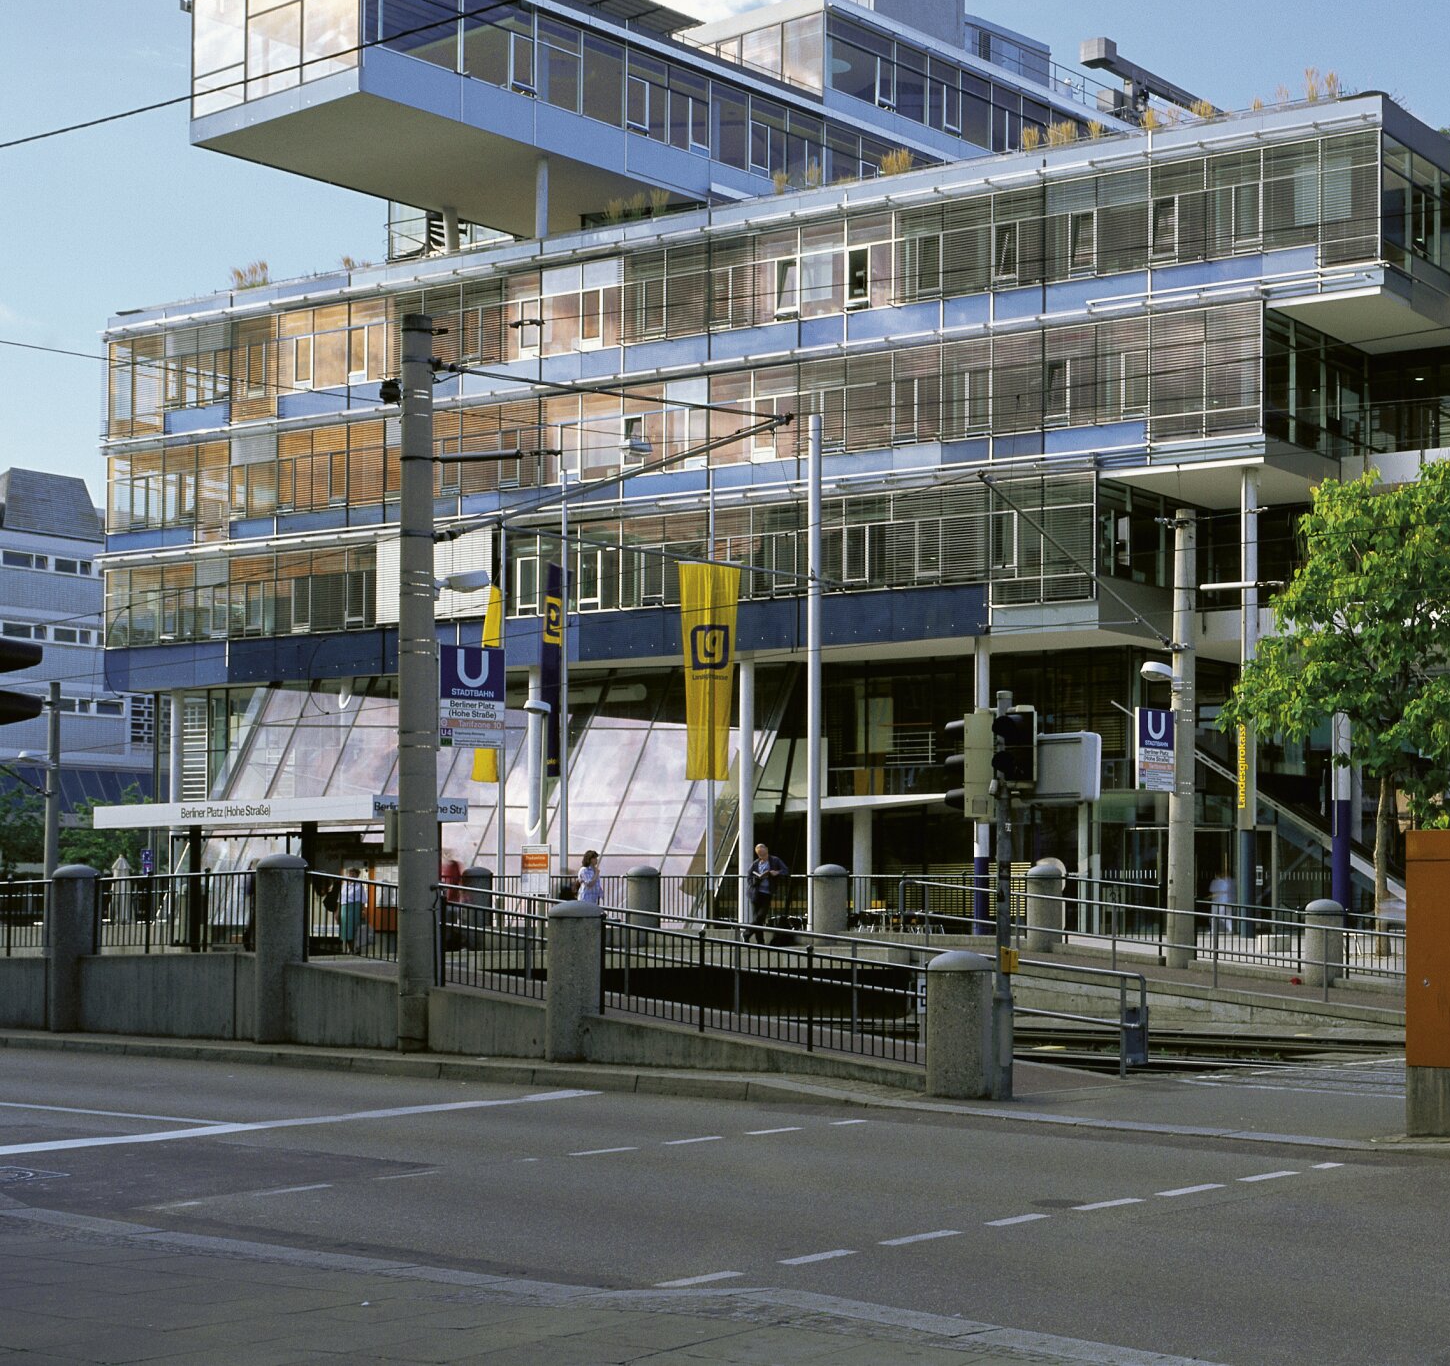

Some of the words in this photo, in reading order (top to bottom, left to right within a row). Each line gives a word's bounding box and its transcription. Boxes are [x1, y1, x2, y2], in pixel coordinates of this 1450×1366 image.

[457, 648, 489, 688] U
[452, 688, 495, 698] STADTBAHN
[450, 700, 476, 709] Berliner
[478, 701, 495, 710] Platz
[448, 709, 471, 719] (Hohe
[472, 710, 497, 721] Straße)
[459, 720, 492, 729] Tarifzone
[1147, 711, 1165, 740] U
[441, 728, 452, 736] U4
[1238, 723, 1248, 809] Landesgirokass
[181, 807, 205, 818] Berliner
[207, 806, 223, 817] Platz
[225, 805, 245, 818] (Hohe
[245, 804, 270, 817] Straße)
[450, 805, 467, 816] Str.)
